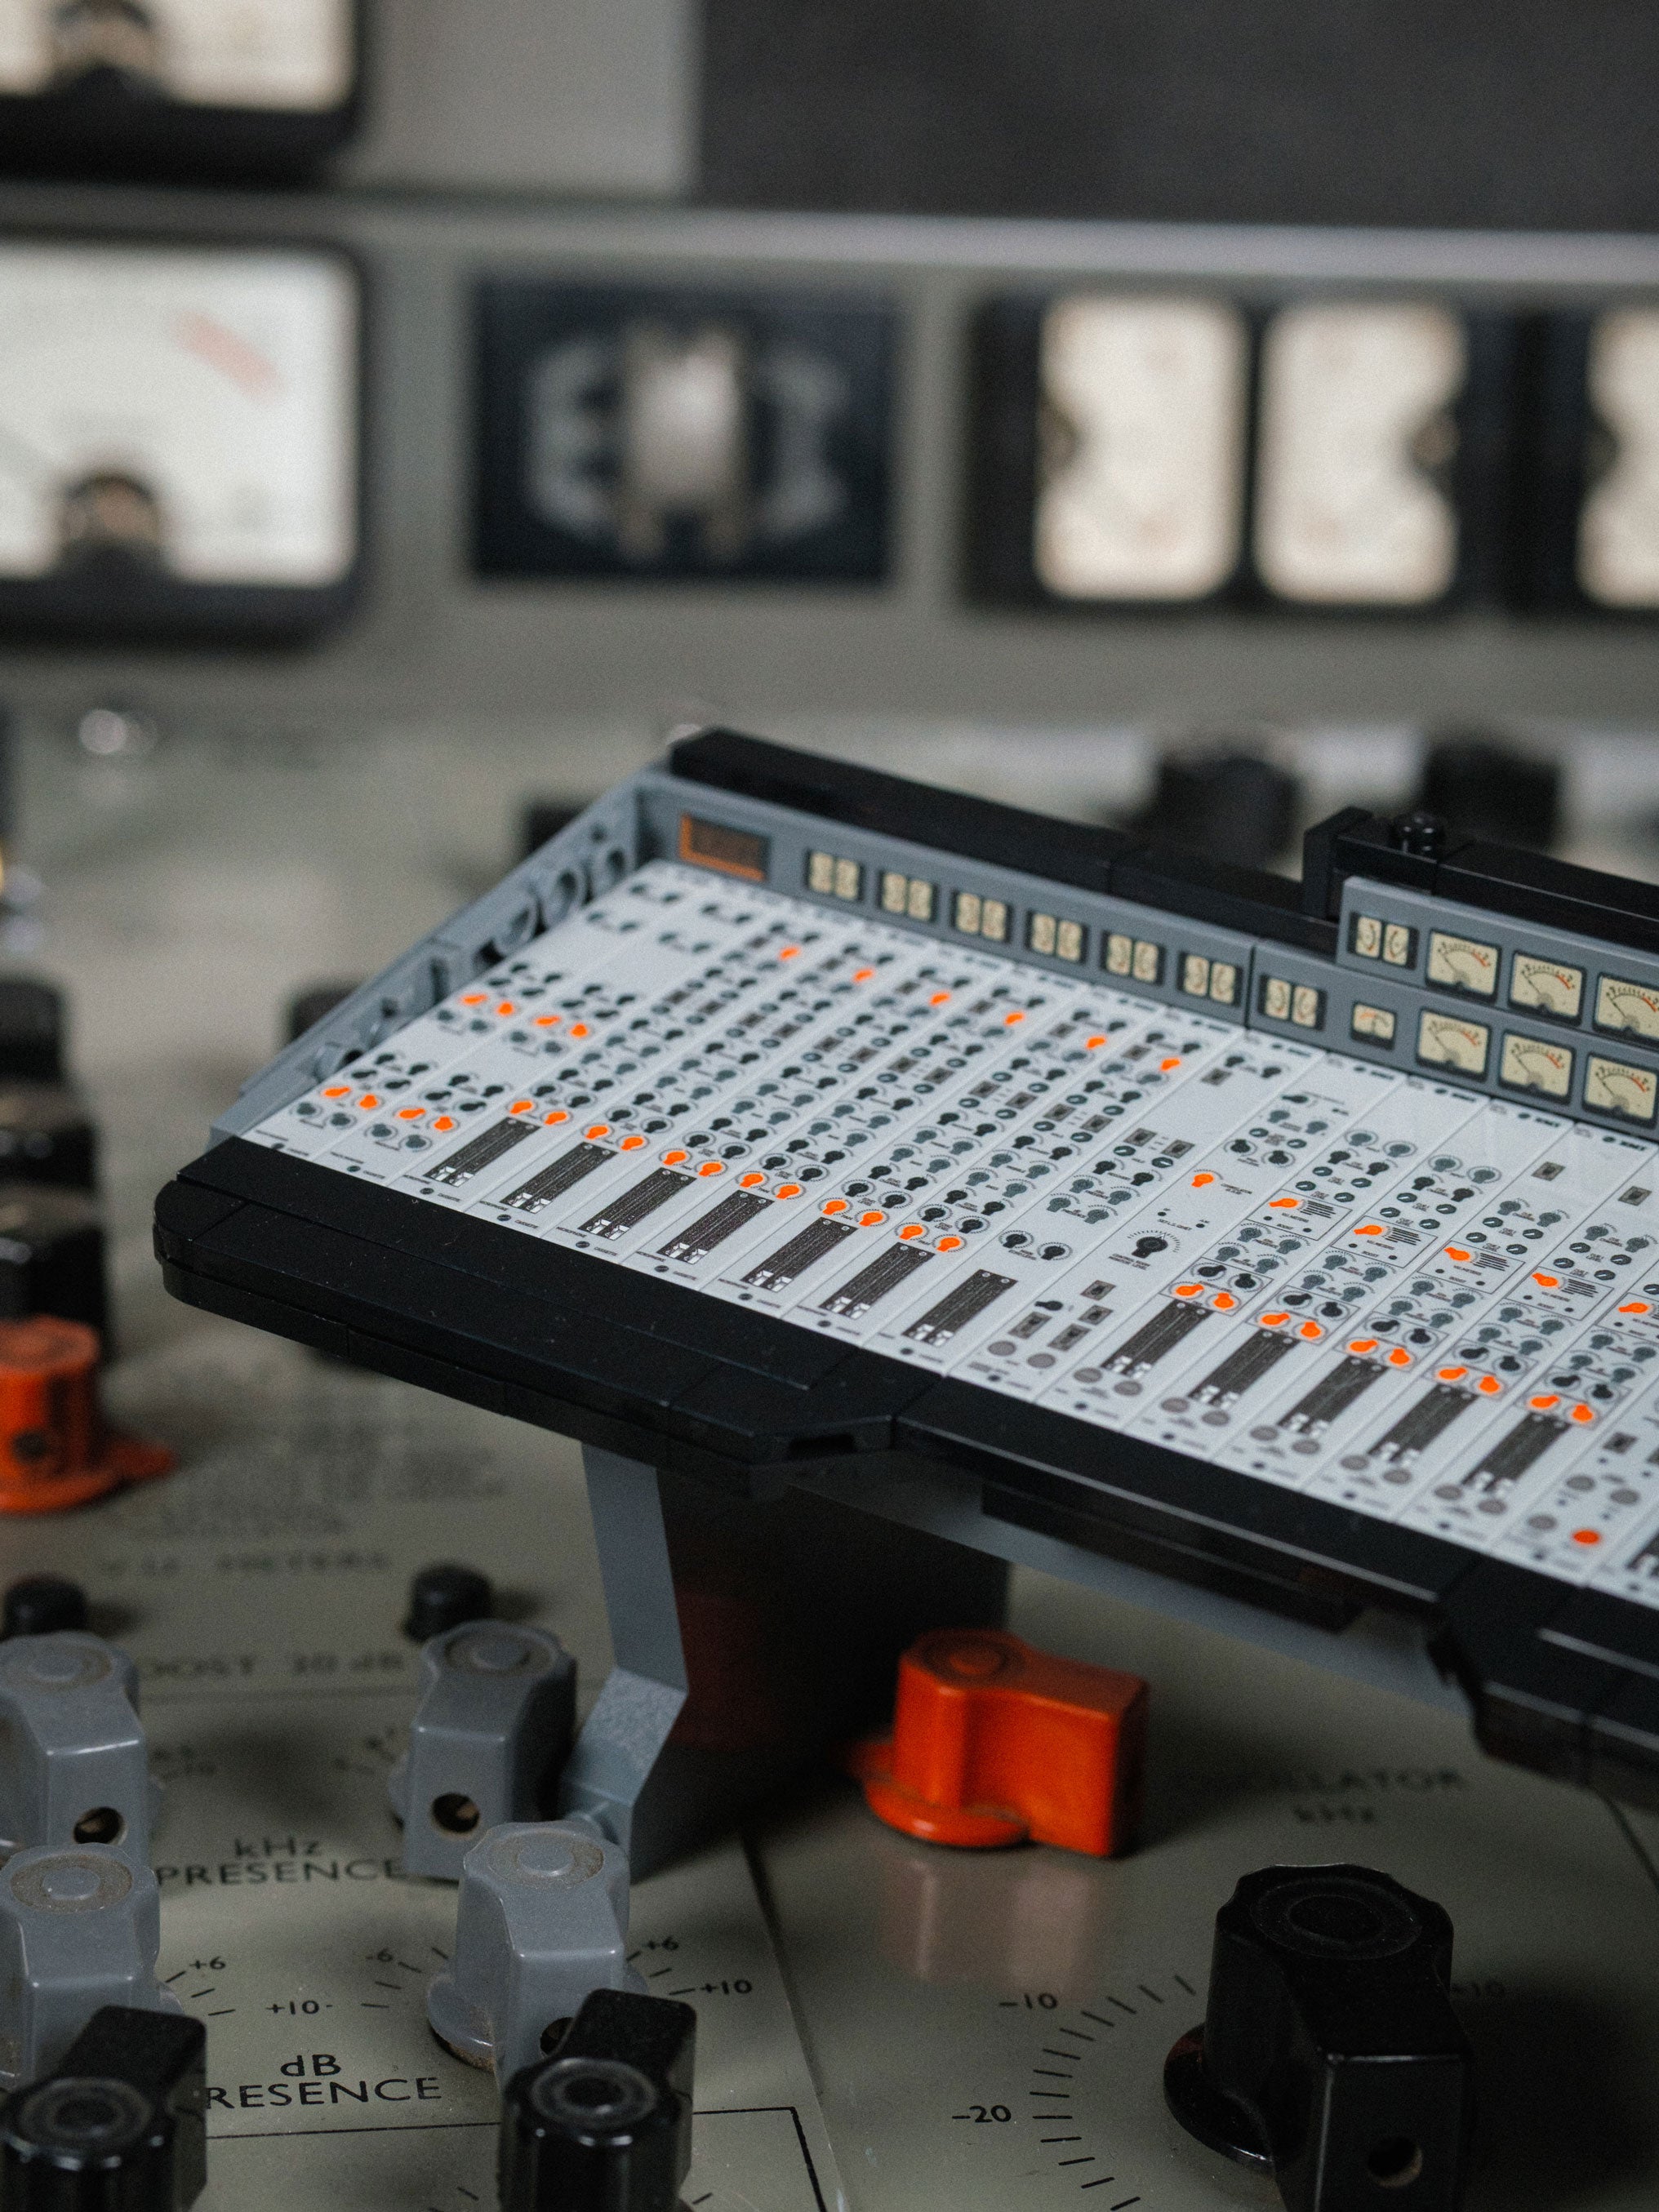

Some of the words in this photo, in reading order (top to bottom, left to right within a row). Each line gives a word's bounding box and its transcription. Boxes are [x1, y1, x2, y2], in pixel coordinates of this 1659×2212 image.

[234, 1837, 322, 1859] kHz
[189, 1956, 226, 1970] +6
[700, 1979, 753, 1996] +10
[999, 1993, 1058, 2010] -10
[280, 2054, 342, 2077] dB
[205, 2077, 443, 2110] RESENCE
[952, 2104, 1012, 2123] -20
